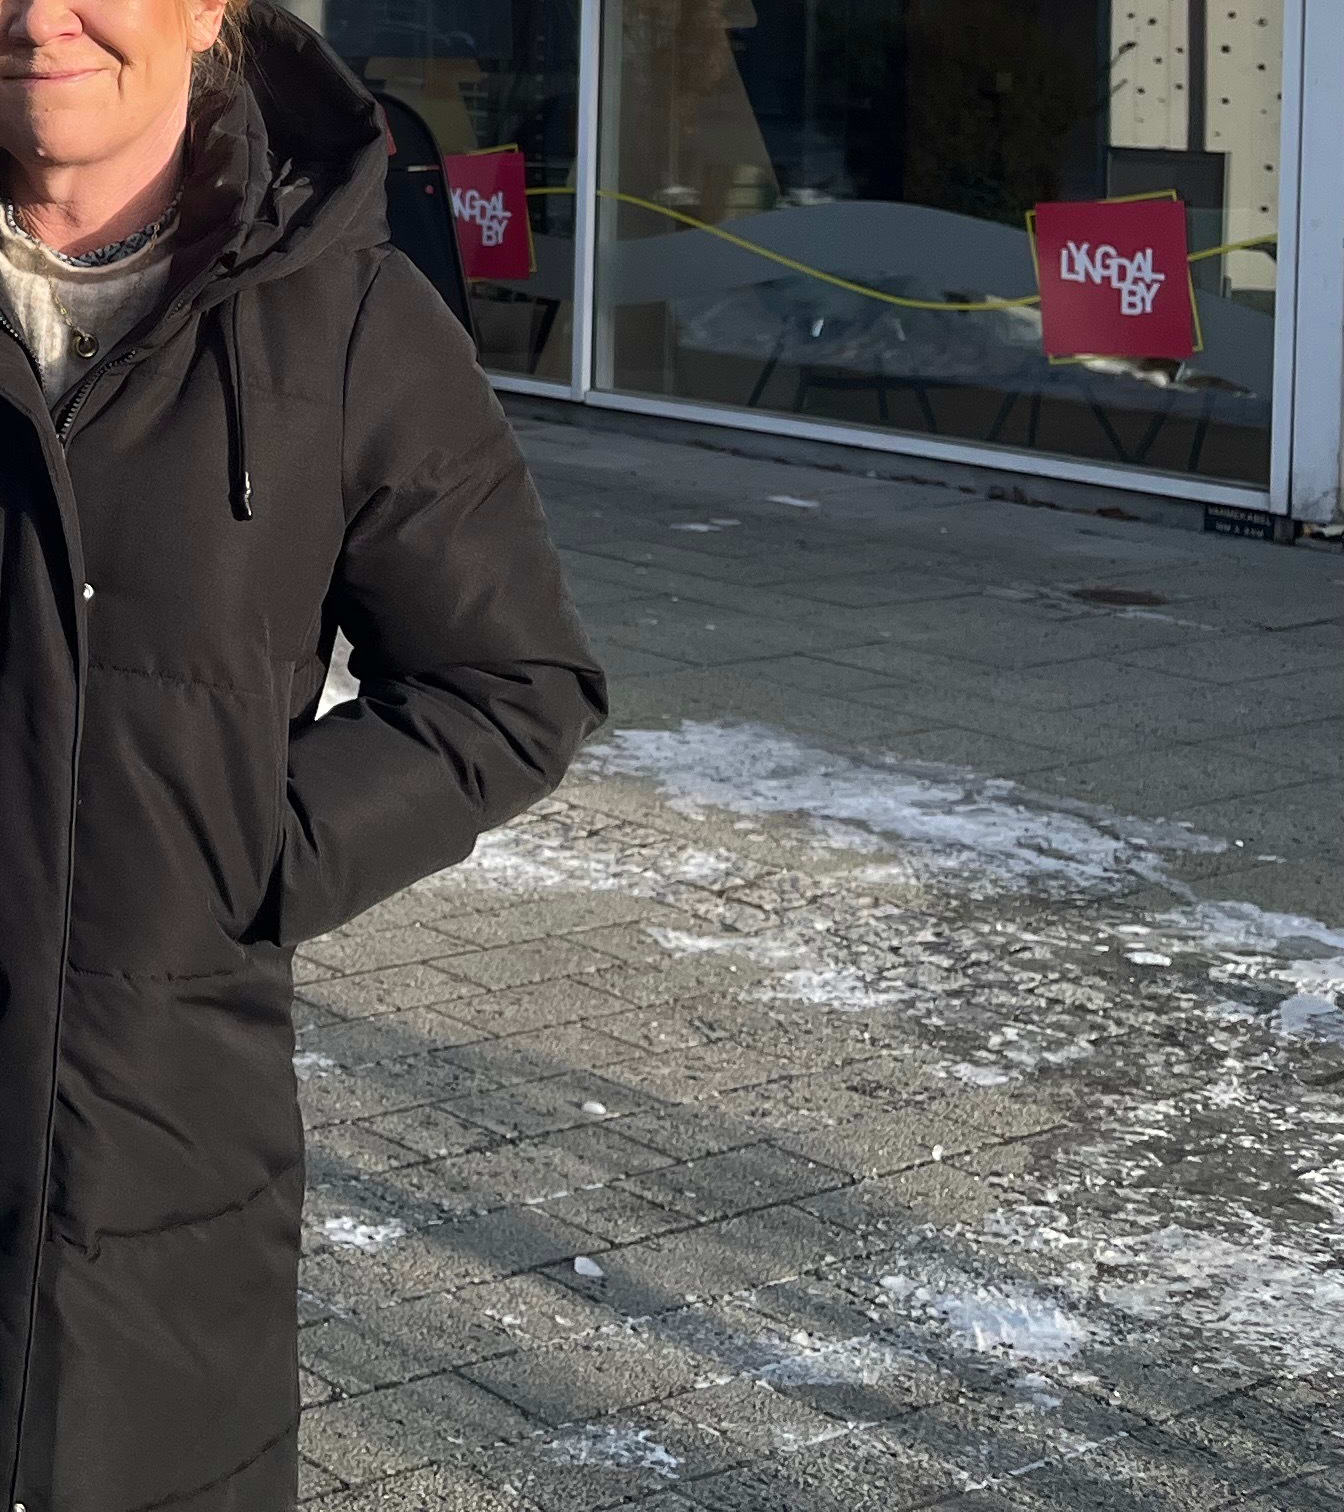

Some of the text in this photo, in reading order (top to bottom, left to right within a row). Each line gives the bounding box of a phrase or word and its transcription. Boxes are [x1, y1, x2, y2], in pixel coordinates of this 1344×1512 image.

[482, 219, 508, 247] BY
[1060, 240, 1166, 289] LYNGDAL
[1121, 282, 1161, 316] BY
